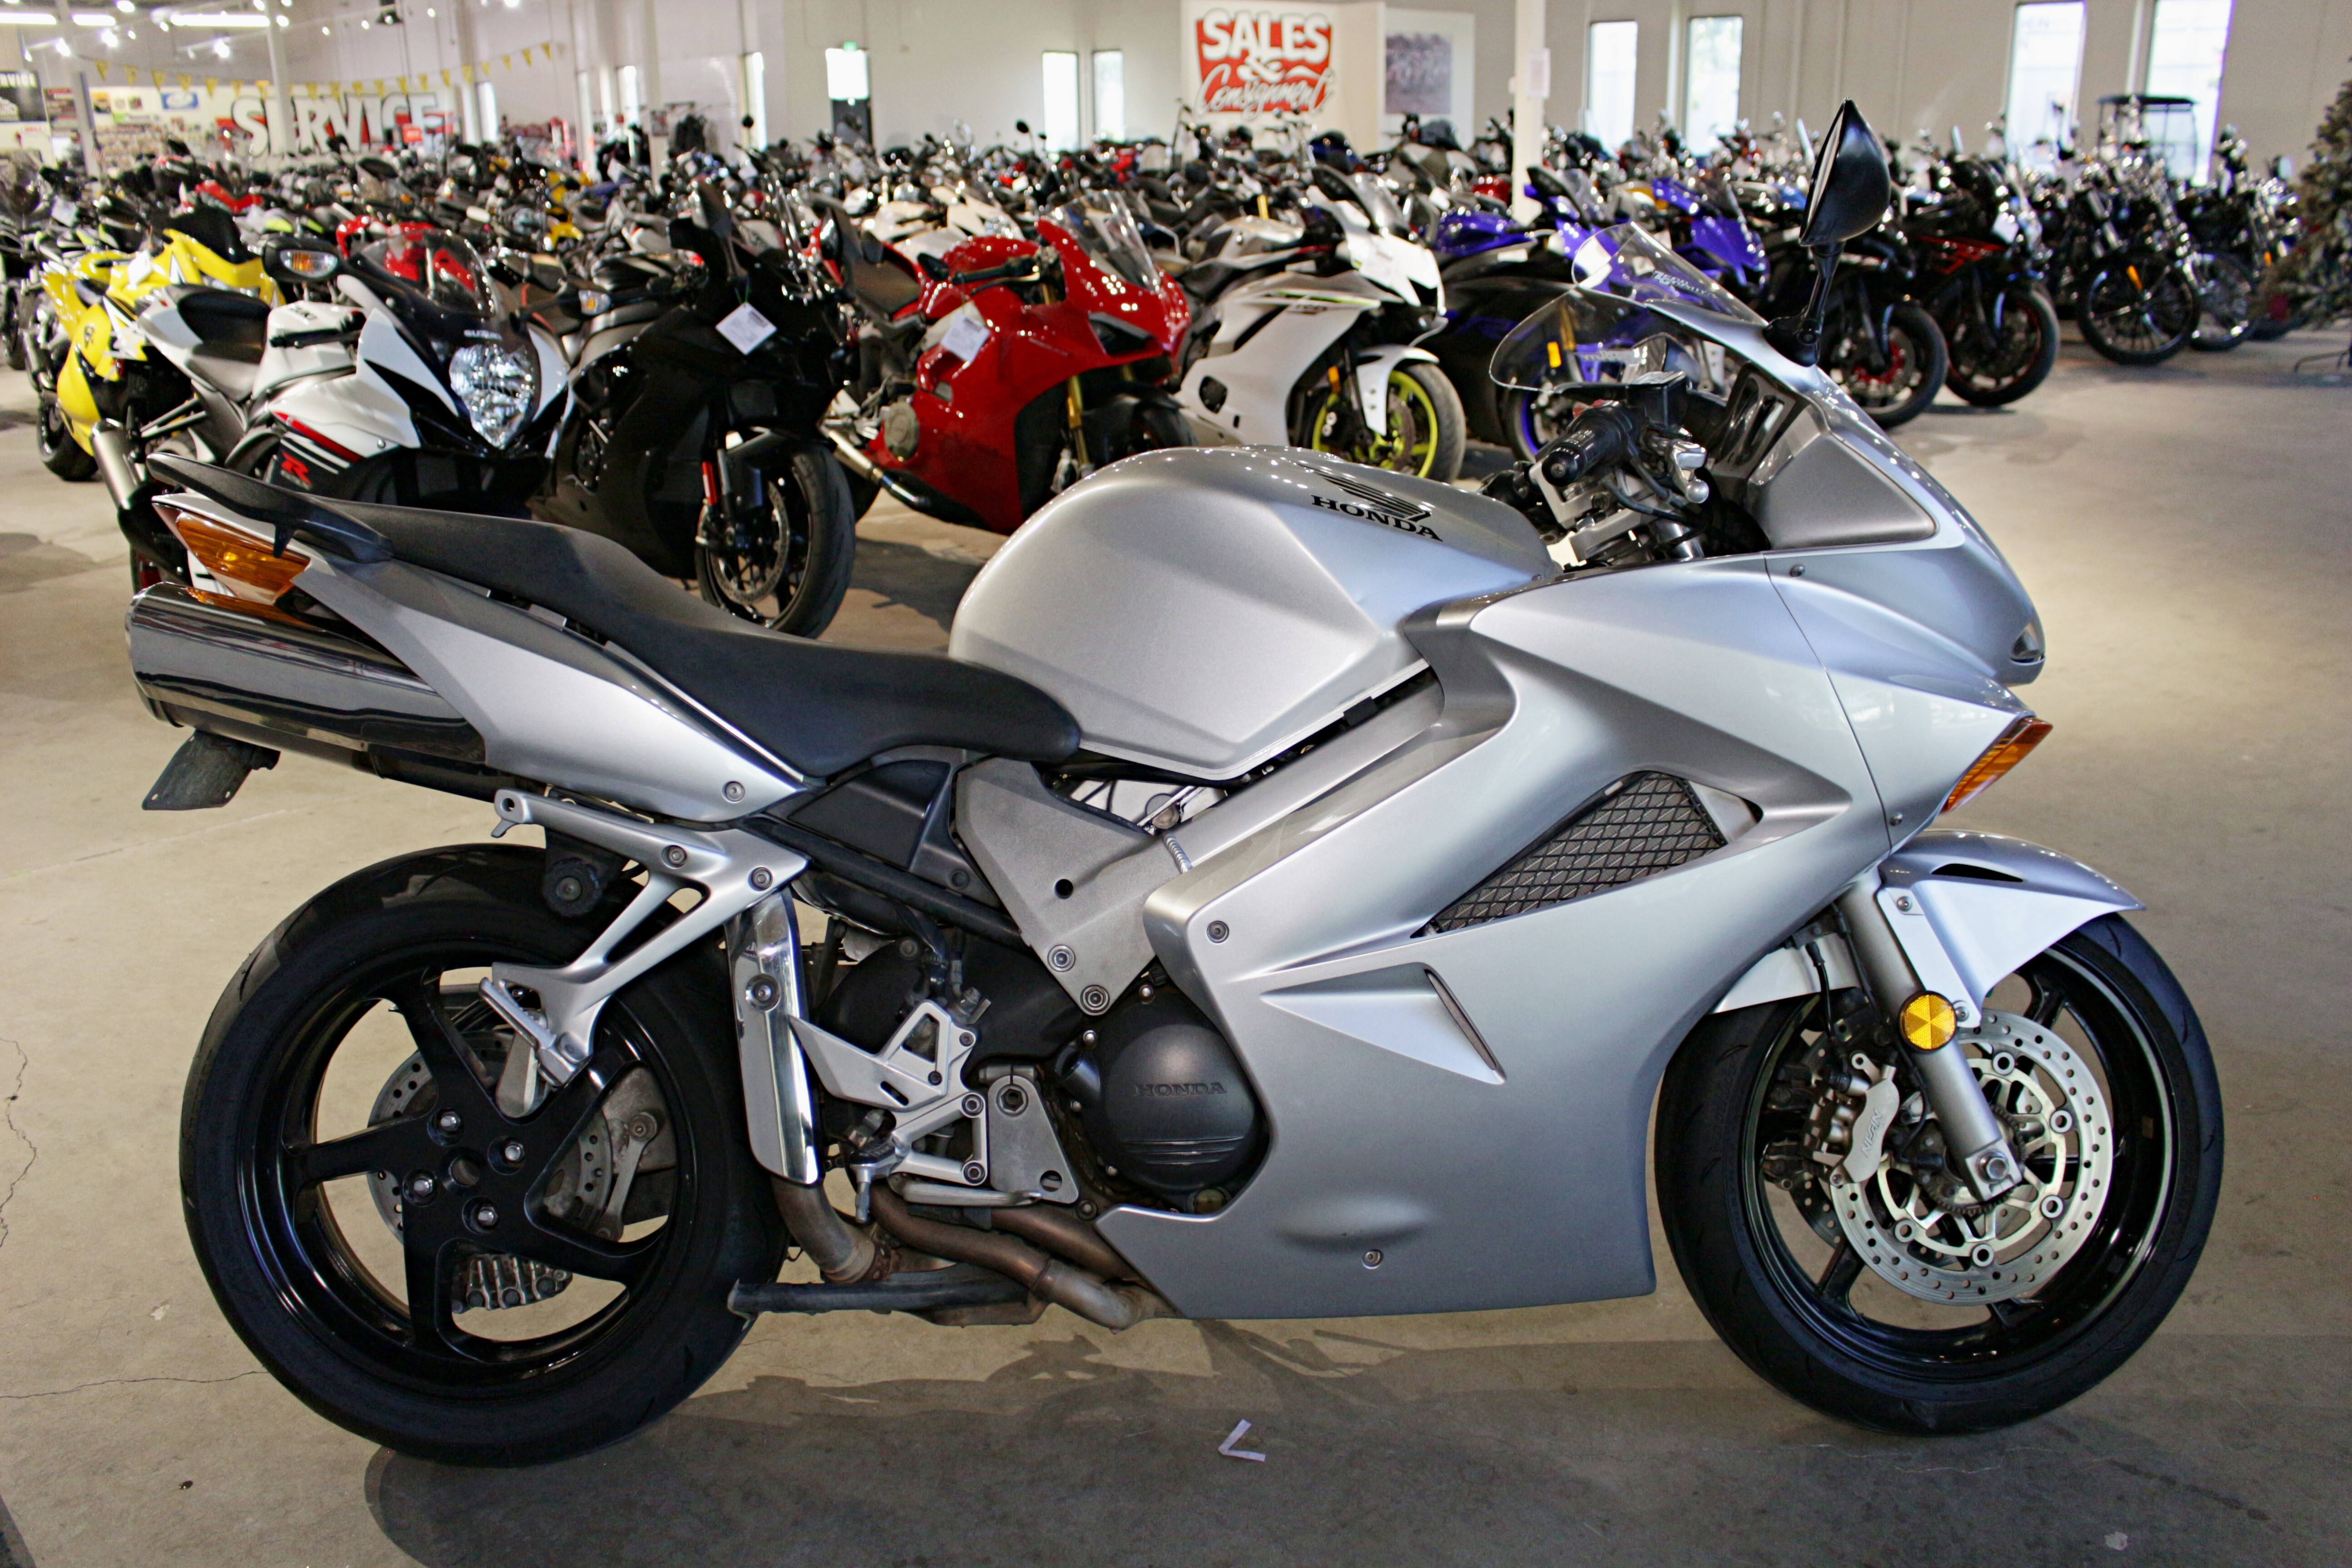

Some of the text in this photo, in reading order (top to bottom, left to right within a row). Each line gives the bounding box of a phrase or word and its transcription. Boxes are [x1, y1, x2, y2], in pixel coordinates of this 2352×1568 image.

[1201, 7, 1330, 64] SALES
[1194, 63, 1335, 121] Consignment
[1236, 54, 1286, 83] &
[1311, 495, 1443, 542] HONDA
[1134, 1083, 1227, 1096] HONDA
[1861, 1107, 1882, 1158] NISSIN
